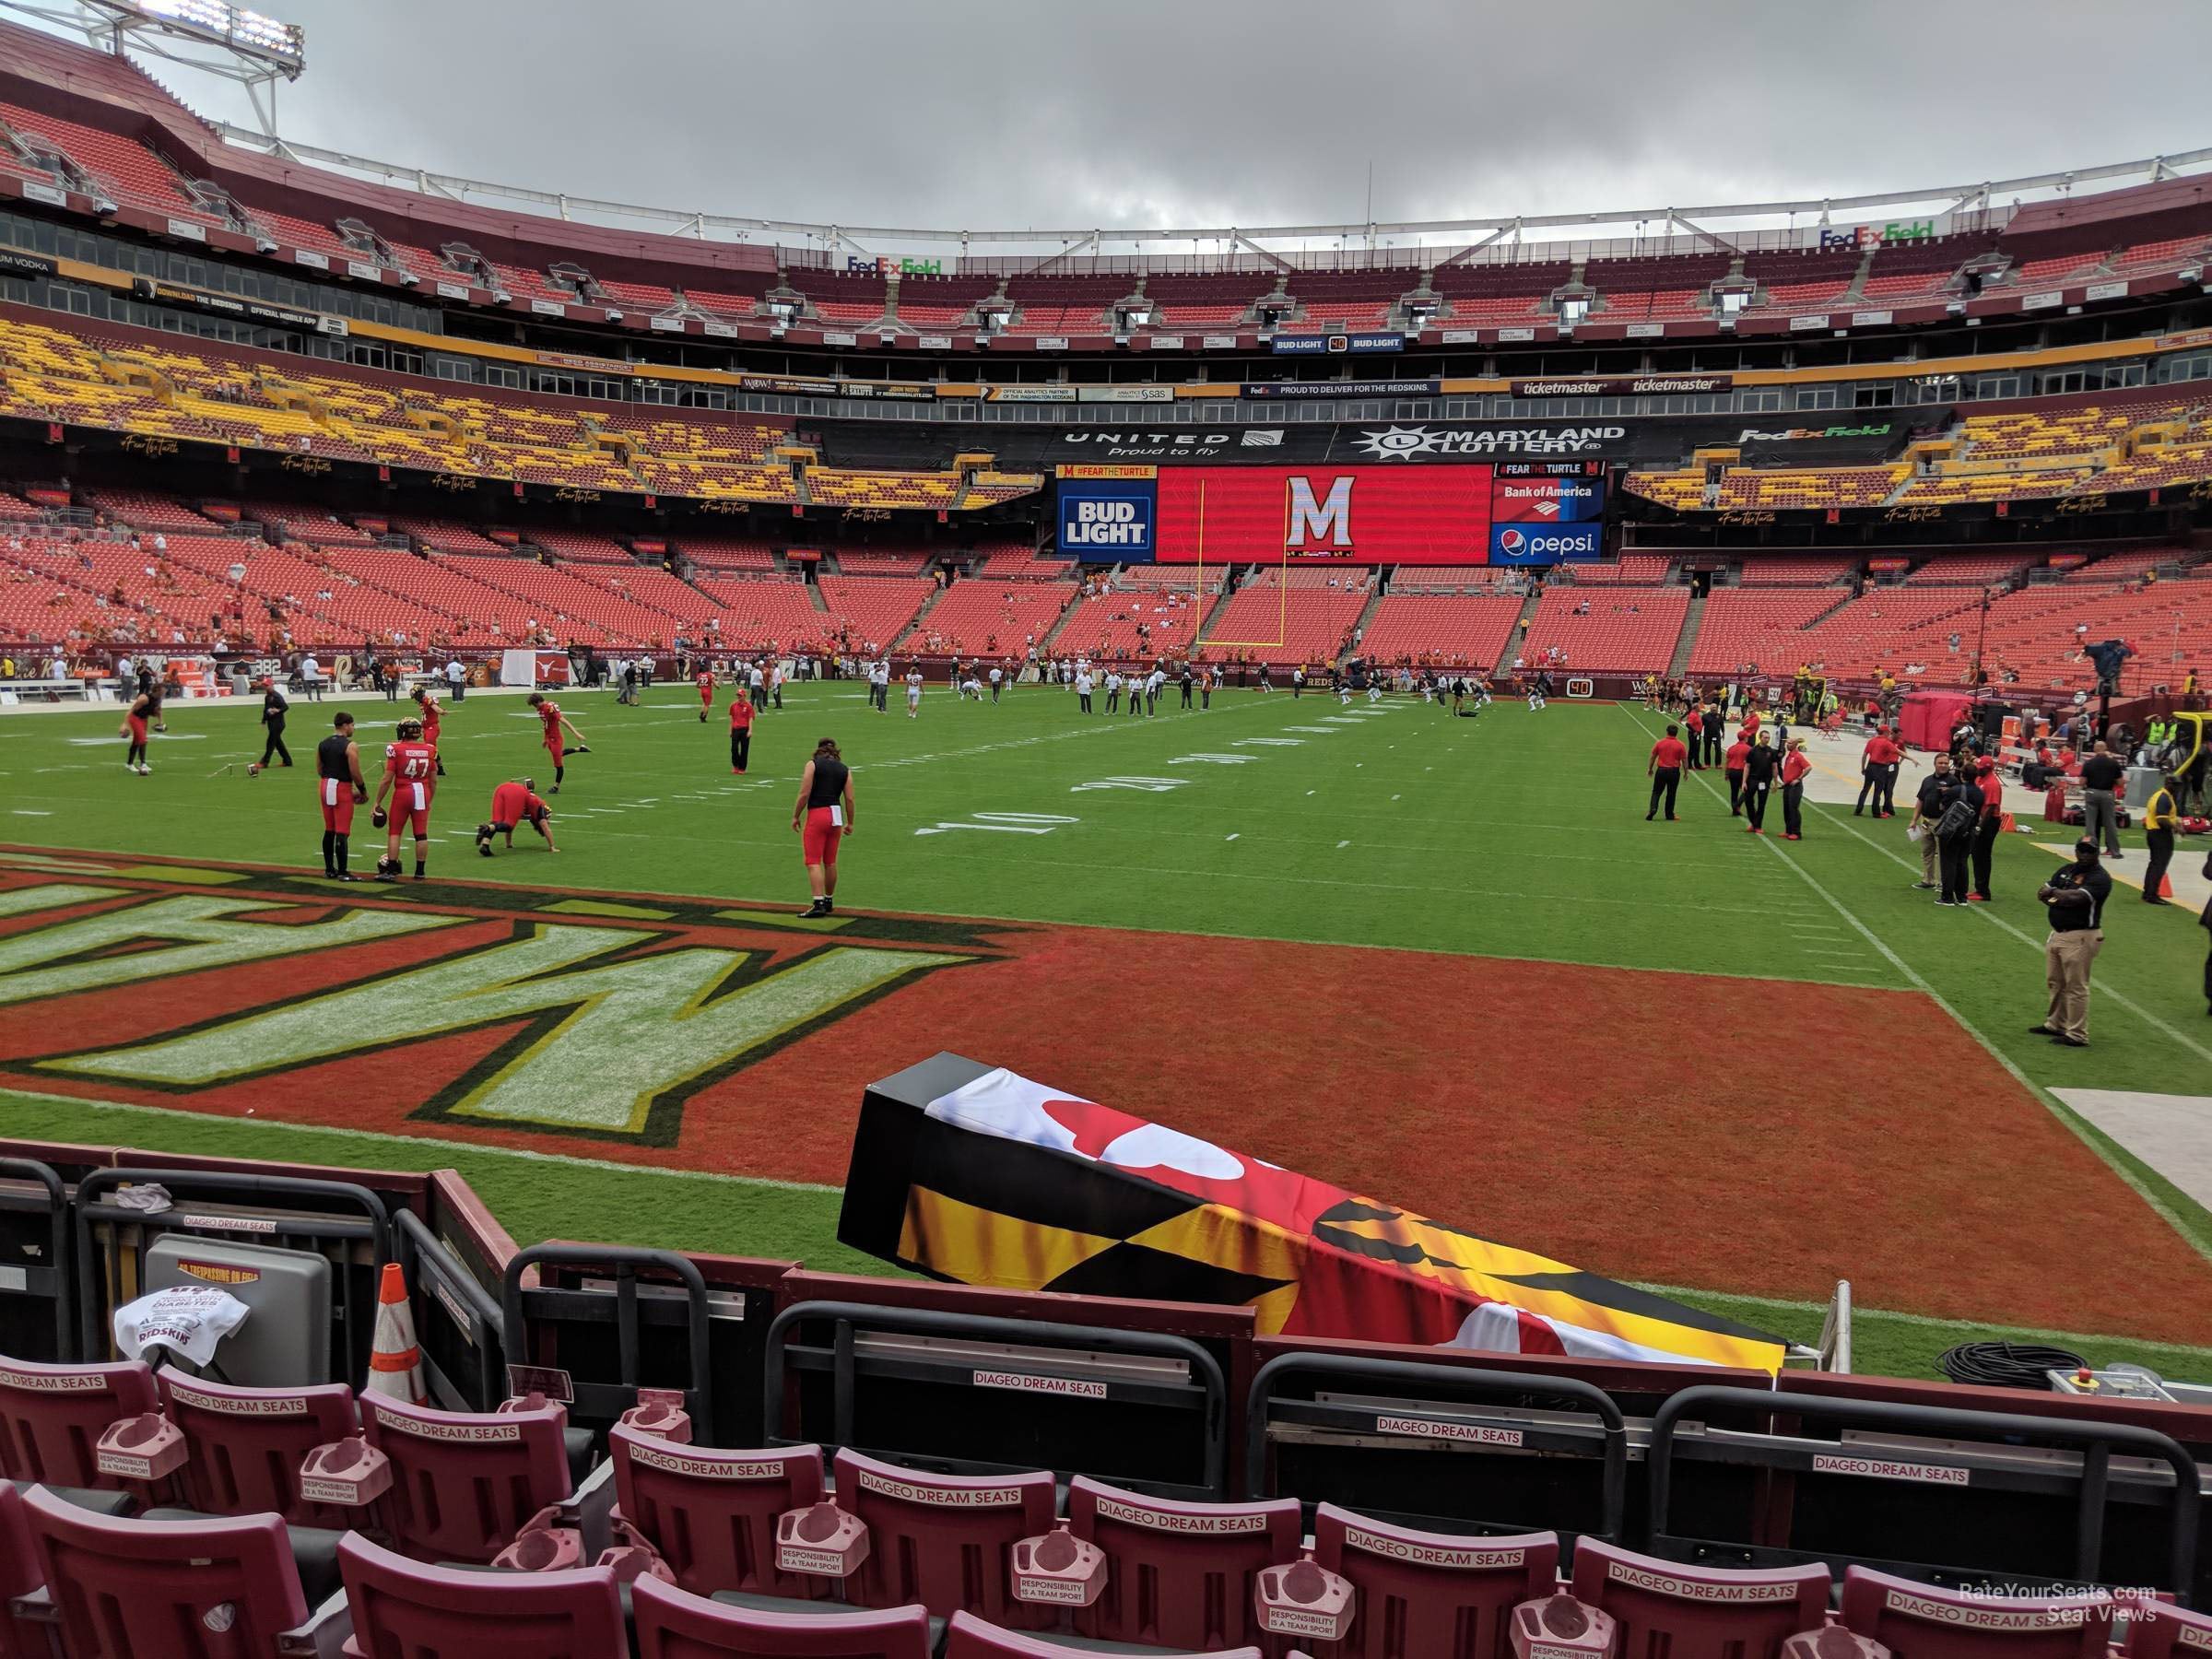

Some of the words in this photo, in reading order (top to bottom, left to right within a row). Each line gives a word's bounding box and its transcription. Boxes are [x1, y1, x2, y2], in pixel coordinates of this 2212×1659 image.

[1820, 220, 1934, 247] FedExField
[15, 258, 48, 272] VODKA
[848, 255, 941, 276] FedExField
[157, 288, 195, 301] DOWNLOAD
[196, 295, 209, 304] THE
[252, 307, 278, 319] OFFICIAL
[279, 312, 303, 324] MOBILE
[304, 315, 316, 324] APP
[1277, 340, 1297, 349] BUD
[1298, 340, 1323, 349] LIGHT
[1331, 338, 1345, 349] 40
[1354, 339, 1372, 347] BUD
[1372, 338, 1400, 347] LIGHT
[850, 388, 873, 396] SALUTE
[1281, 386, 1308, 394] PROUD
[1321, 385, 1352, 394] DELIVER
[1371, 384, 1386, 393] THE
[1065, 433, 1230, 443] UNITED
[1445, 427, 1625, 441] MARYLAND
[1739, 425, 1890, 442] FedExField
[1108, 447, 1164, 456] Proud
[1170, 447, 1190, 455] to
[1195, 447, 1220, 456] fly
[1439, 439, 1589, 453] LOTTERY
[1504, 486, 1534, 498] Bank
[1534, 486, 1547, 498] of
[1547, 486, 1592, 498] America
[1078, 501, 1135, 523] BUD
[1287, 476, 1356, 546] M
[1066, 523, 1145, 543] LIGHT
[1531, 533, 1591, 555] pepsi
[908, 677, 919, 687] 49
[1571, 682, 1589, 694] 40
[405, 759, 429, 778] 47
[1082, 777, 1192, 791] 20
[935, 812, 1080, 834] 10
[185, 1218, 217, 1228] DIAGEO
[218, 1219, 248, 1230] DREAM
[250, 1222, 274, 1231] SEATS
[190, 1265, 229, 1282] TRESPASSING
[231, 1270, 240, 1283] ON
[13, 1375, 58, 1389] DREAM
[62, 1375, 103, 1389] SEATS
[975, 1372, 1021, 1387] DIAGEO
[1024, 1377, 1066, 1392] DREAM
[1069, 1382, 1105, 1395] SEATS
[172, 1386, 210, 1408] DIAGEO
[212, 1398, 259, 1412] DREAM
[263, 1398, 304, 1412] SEATS
[377, 1410, 418, 1432] DIAGEO
[422, 1425, 471, 1439] DREAM
[475, 1426, 517, 1440] SEATS
[1379, 1418, 1429, 1434] DIAGEO
[1431, 1424, 1478, 1440] DREAM
[1482, 1430, 1520, 1443] SEATS
[100, 1453, 148, 1467] RESPONSIBILITY
[631, 1447, 677, 1470] DIAGEO
[681, 1461, 733, 1476] DREAM
[737, 1464, 781, 1476] SEATS
[1815, 1457, 1869, 1473] DIAGEO
[1871, 1463, 1923, 1479] DREAM
[1925, 1467, 1966, 1482] SEATS
[304, 1480, 355, 1492] RESPONSIBILITY
[861, 1474, 912, 1498] DIAGEO
[916, 1488, 971, 1503] DREAM
[975, 1490, 1018, 1503] SEATS
[1099, 1500, 1154, 1524] DIAGEO
[1159, 1515, 1214, 1531] DREAM
[1219, 1517, 1264, 1531] SEATS
[1348, 1531, 1408, 1557] DIAGEO
[1413, 1548, 1471, 1565] DREAM
[1476, 1551, 1522, 1565] SEATS
[783, 1550, 841, 1562] RESPONSIBILITY
[798, 1560, 817, 1569] TEAM
[818, 1562, 841, 1571] SPORT
[1021, 1581, 1082, 1592] RESPONSIBILITY
[1613, 1566, 1677, 1592] DIAGEO
[1682, 1583, 1743, 1600] DREAM
[1747, 1585, 1794, 1599] SEATS
[1037, 1590, 1058, 1599] TEAM
[1059, 1592, 1082, 1601] SPORT
[1271, 1610, 1334, 1625] RESPONSIBILITY
[1891, 1594, 1960, 1620] DIAGEO
[1966, 1612, 2030, 1628] DREAM
[1287, 1622, 1308, 1631] TEAM
[1309, 1625, 1333, 1634] SPORT
